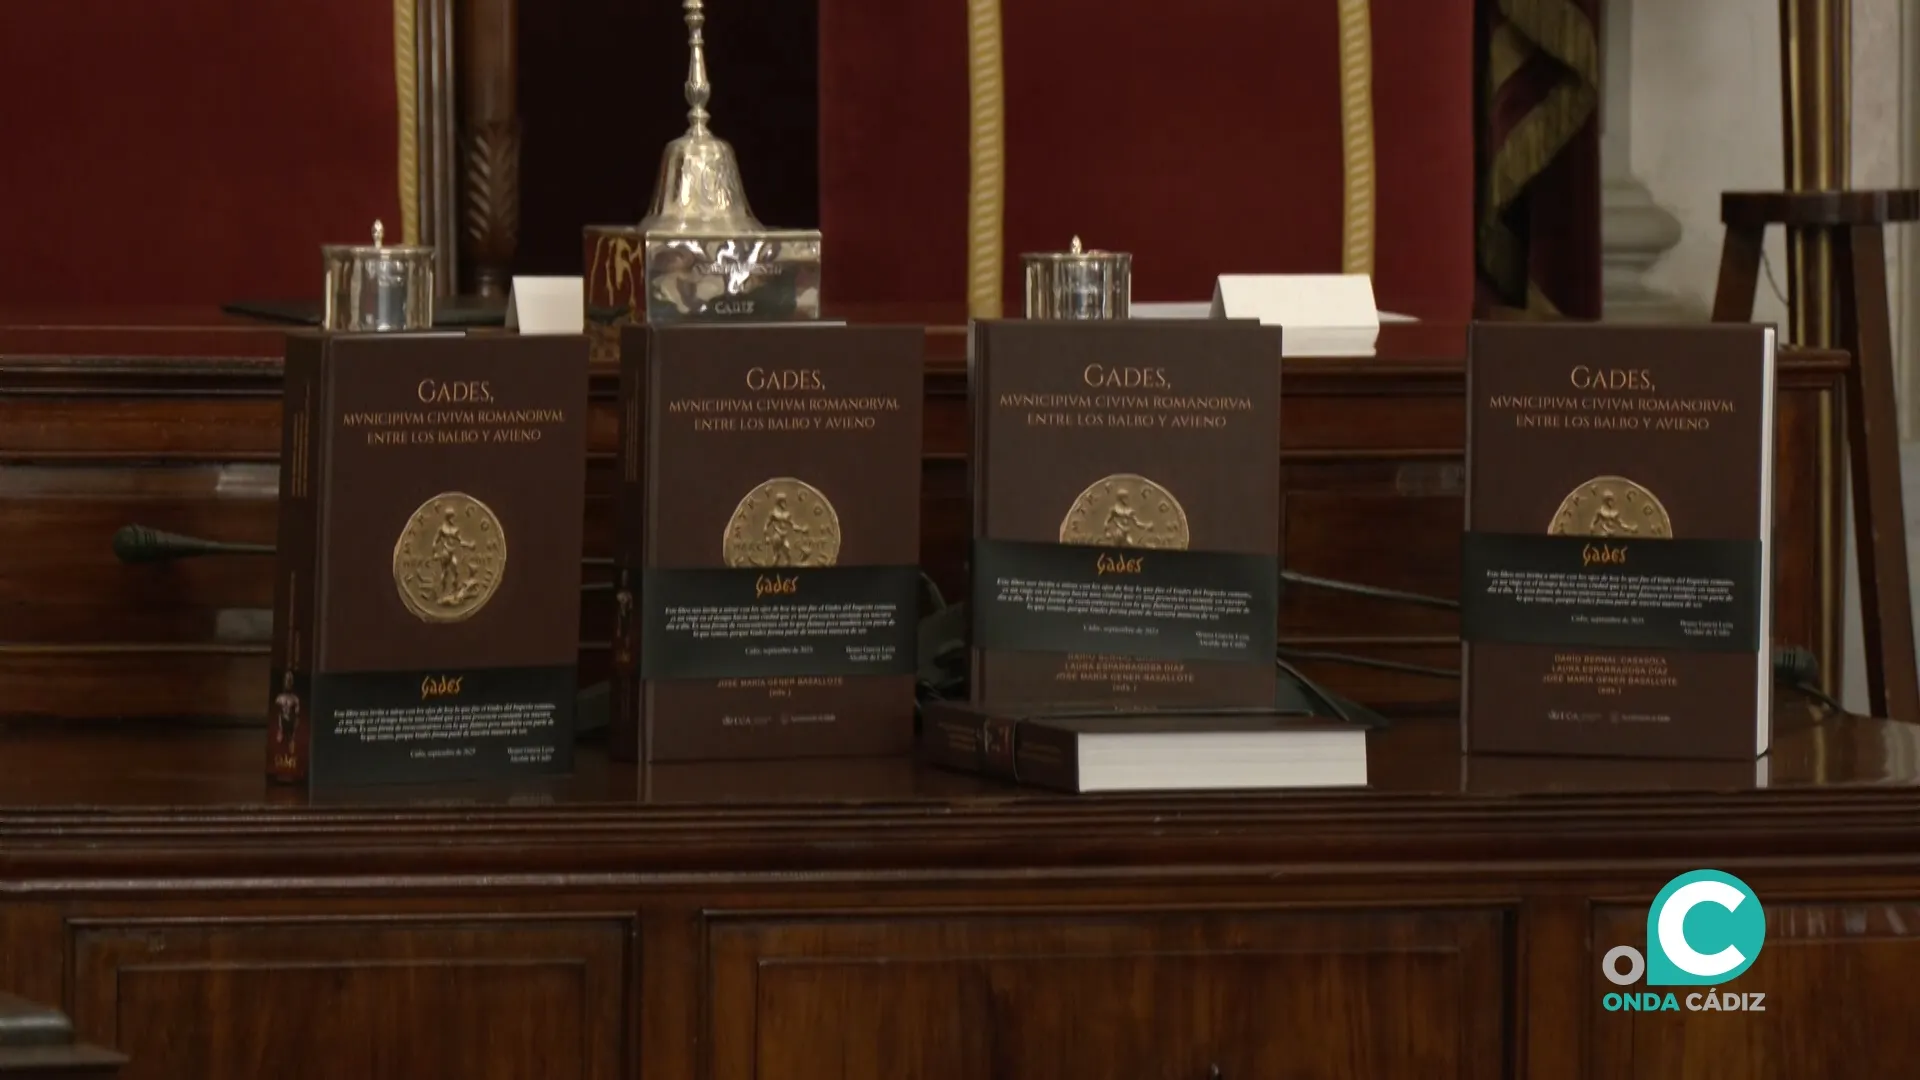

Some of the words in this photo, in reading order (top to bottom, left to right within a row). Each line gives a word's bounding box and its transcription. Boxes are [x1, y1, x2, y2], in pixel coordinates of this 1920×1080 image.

[669, 398, 752, 413] MVNICIPIVM
[756, 398, 806, 412] CIVIVM
[1000, 394, 1092, 408] MVNICIPIVM
[1095, 395, 1149, 409] CIVIVM
[1490, 395, 1578, 410] MVNICIPIVM
[1581, 396, 1634, 411] CIVIVM
[343, 411, 424, 426] MVNICIPIVM
[427, 410, 475, 424] CIVIVM
[694, 418, 736, 431] ENTRE
[740, 418, 765, 431] LOS
[768, 417, 810, 430] BALBO
[814, 417, 823, 430] Y
[825, 417, 876, 430] AVIENO
[1027, 413, 1072, 426] ENTRE
[1077, 414, 1104, 427] LOS
[1108, 414, 1153, 428] BALBO
[1158, 415, 1168, 428] Y
[1170, 415, 1227, 429] AVIENO
[1516, 414, 1560, 428] ENTRE
[1564, 415, 1590, 429] LOS
[1594, 416, 1639, 430] BALBO
[1643, 417, 1652, 430] Y
[1655, 417, 1710, 431] AVIENO
[367, 431, 407, 445] ENTRE
[411, 430, 434, 444] LOS
[438, 429, 478, 443] BALBO
[482, 429, 491, 443] Y
[493, 428, 542, 442] AVIENO
[1582, 543, 1628, 567] Gades
[1096, 552, 1144, 576] Gades
[755, 573, 799, 598] Gades
[421, 675, 464, 700] Gades
